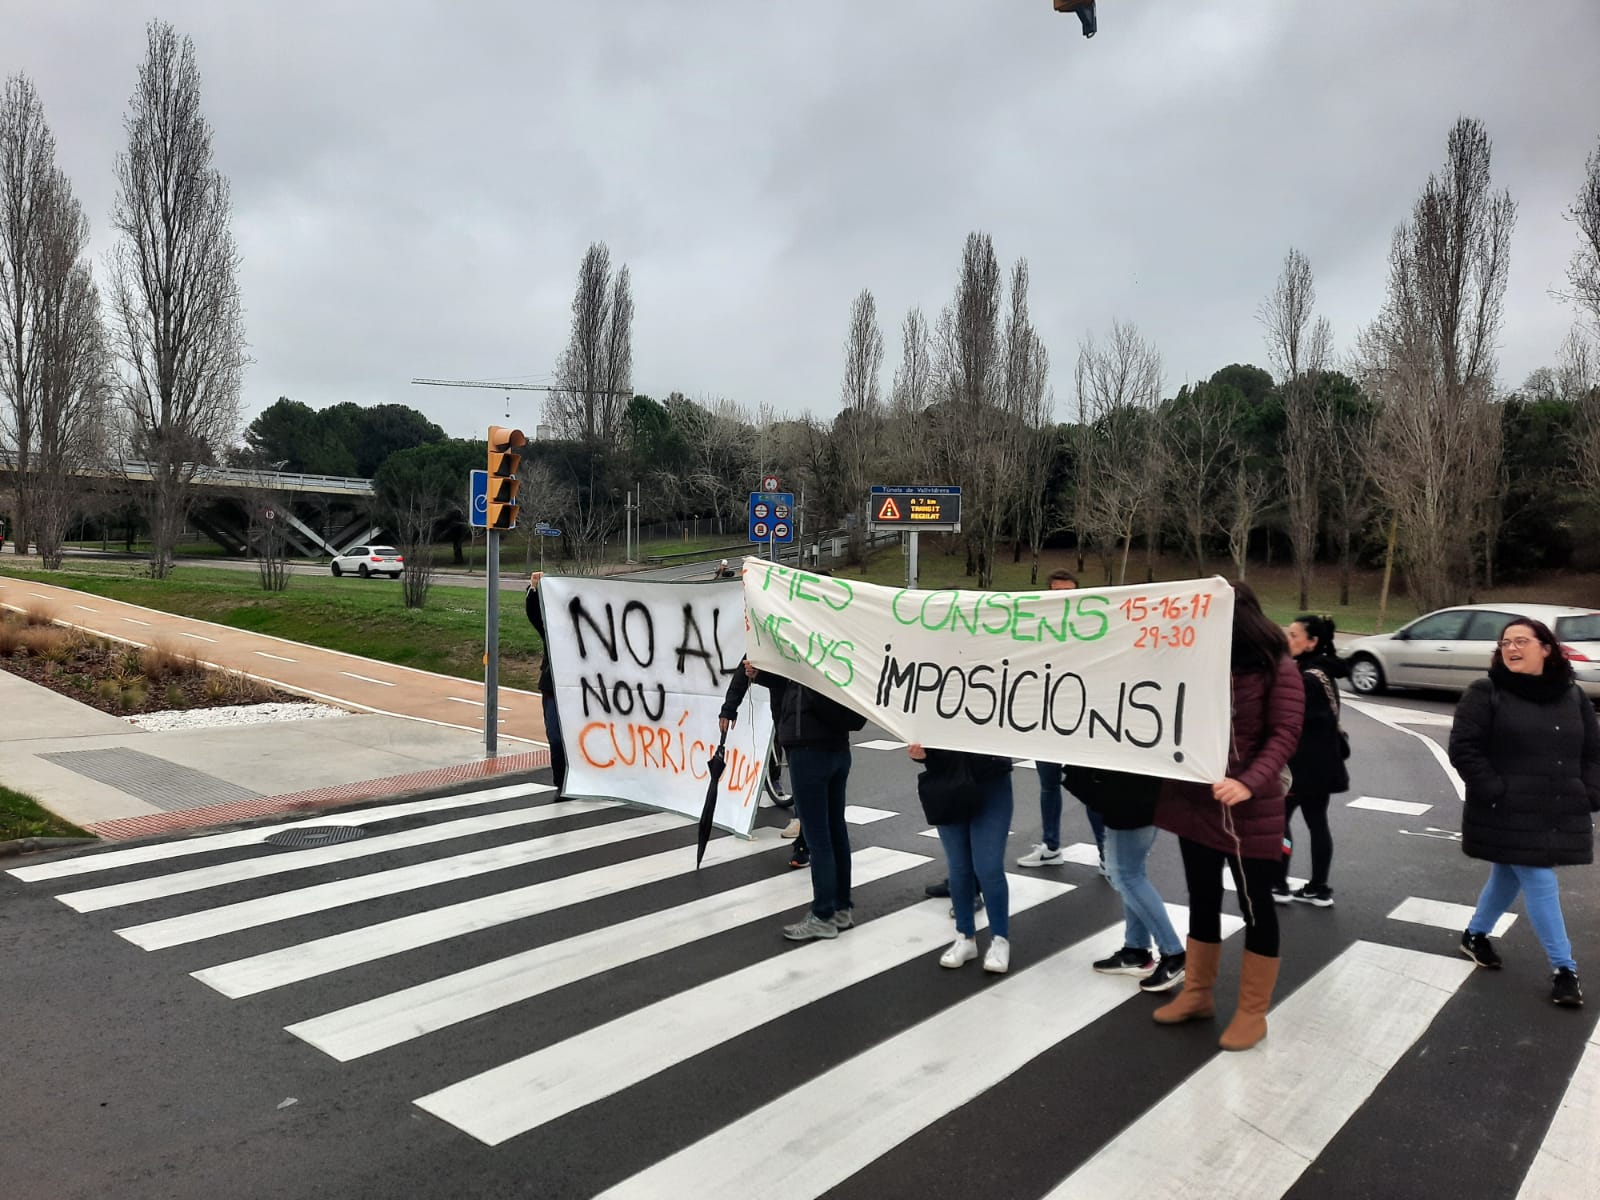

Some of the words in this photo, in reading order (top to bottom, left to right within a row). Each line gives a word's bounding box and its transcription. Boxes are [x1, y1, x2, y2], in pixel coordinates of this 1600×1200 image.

[892, 587, 1110, 644] CONSENS
[1119, 593, 1213, 623] 15-16-17
[568, 595, 655, 668] NO
[675, 602, 738, 687] AL
[1133, 624, 1197, 650] 29-30
[580, 673, 666, 722] NOU
